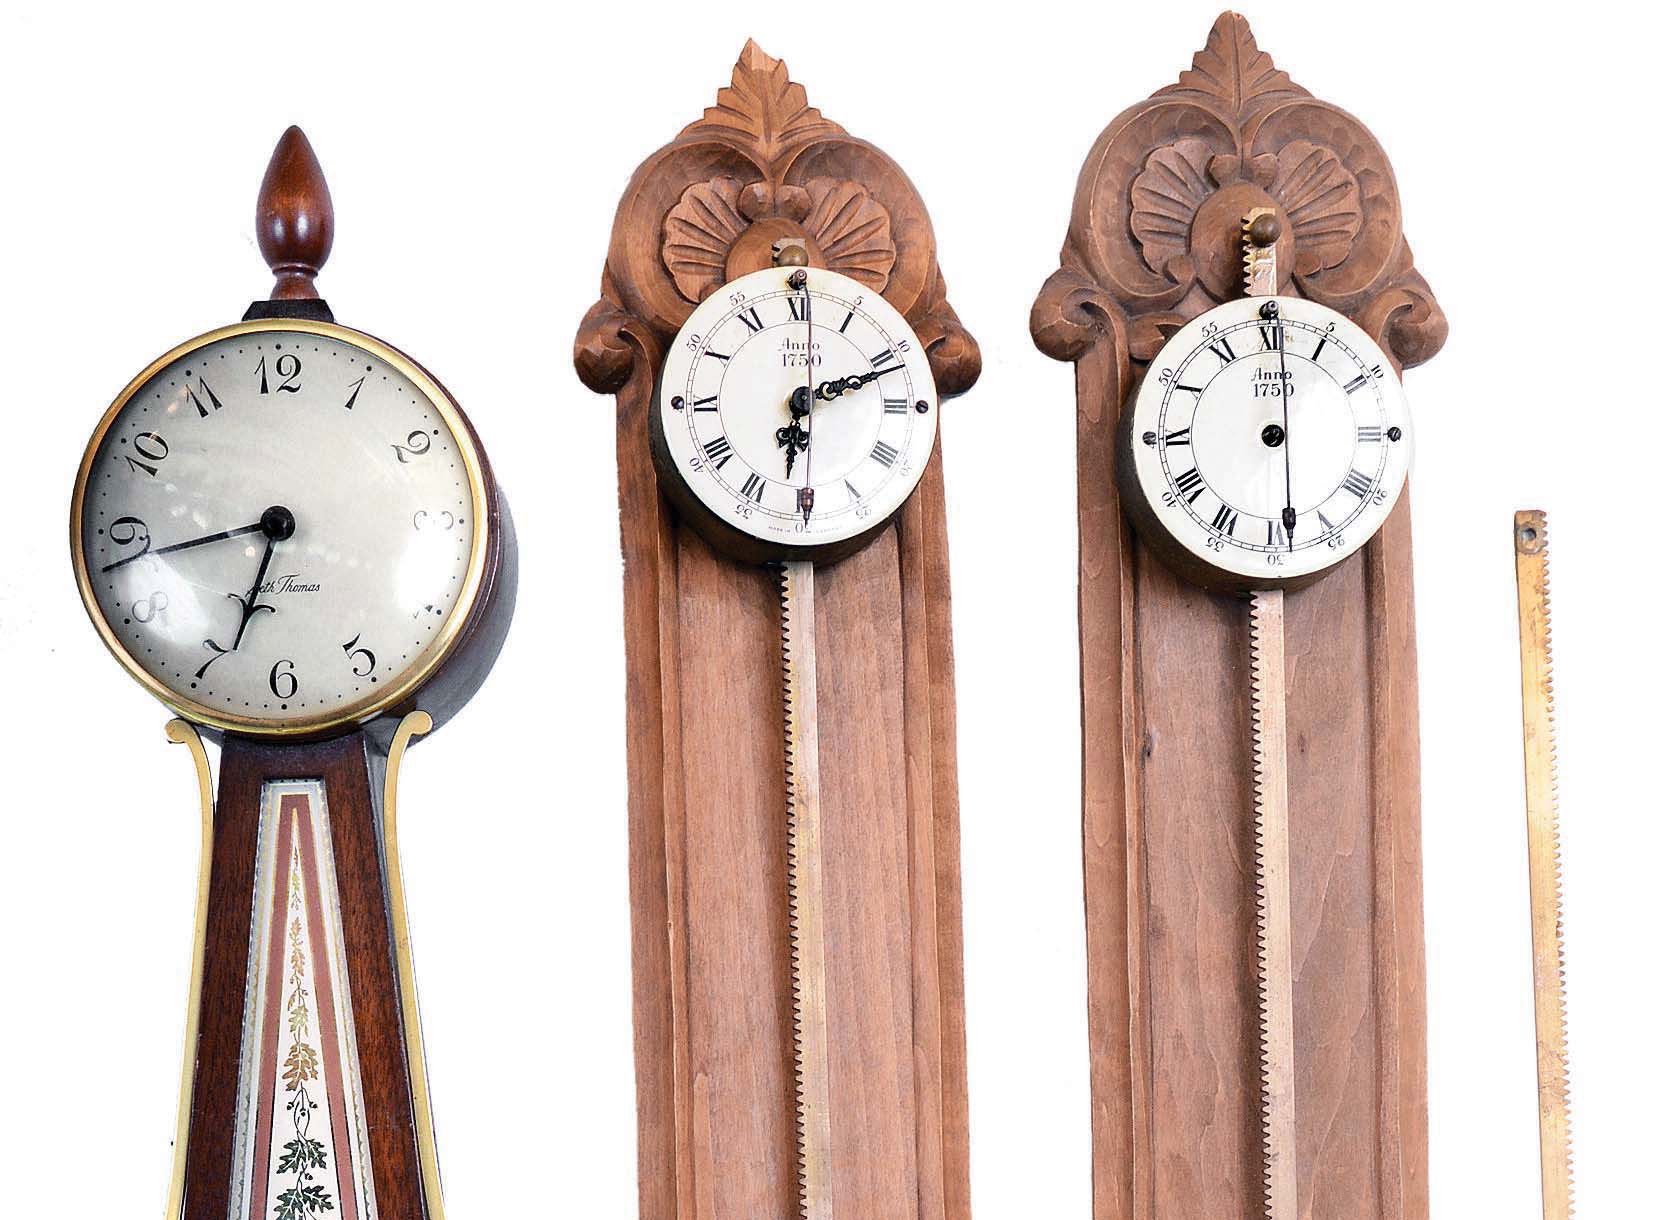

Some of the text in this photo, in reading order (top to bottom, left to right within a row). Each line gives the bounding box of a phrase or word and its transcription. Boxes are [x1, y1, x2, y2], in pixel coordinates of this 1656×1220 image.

[729, 291, 746, 306] 55
[784, 297, 811, 321] XII
[853, 296, 864, 306] 5
[737, 307, 764, 337] XI
[1202, 321, 1217, 337] 55
[1326, 321, 1336, 332] 5
[686, 334, 701, 352] 50
[778, 338, 820, 351] Anno
[897, 340, 911, 353] 10
[1258, 326, 1284, 351] XII
[704, 344, 731, 368] X
[782, 354, 822, 367] 1750
[1208, 337, 1237, 368] XI
[254, 353, 302, 395] 12
[1159, 368, 1173, 386] 50
[1251, 368, 1292, 381] Anno
[1370, 364, 1384, 379] 10
[344, 376, 364, 410] 1
[1254, 384, 1294, 397] 1750
[1343, 374, 1368, 395] II
[186, 376, 222, 418] 11
[693, 392, 718, 413] IX
[884, 398, 907, 414] III
[1165, 425, 1190, 448] IX
[1358, 426, 1381, 442] III
[125, 431, 169, 477] 10
[391, 430, 431, 463] 2
[703, 434, 735, 470] VIII
[689, 457, 704, 473] 40
[740, 472, 766, 503] VII
[1175, 465, 1206, 505] VIII
[1161, 491, 1176, 508] 40
[1373, 488, 1388, 506] 20
[109, 516, 151, 546] 9
[1211, 504, 1238, 536] VII
[1267, 520, 1285, 545] VI
[1205, 537, 1224, 552] 35
[245, 574, 321, 597] eth Thomas
[132, 591, 168, 623] 8
[194, 638, 230, 679] 7
[342, 633, 376, 677] 5
[269, 659, 298, 699] 6
